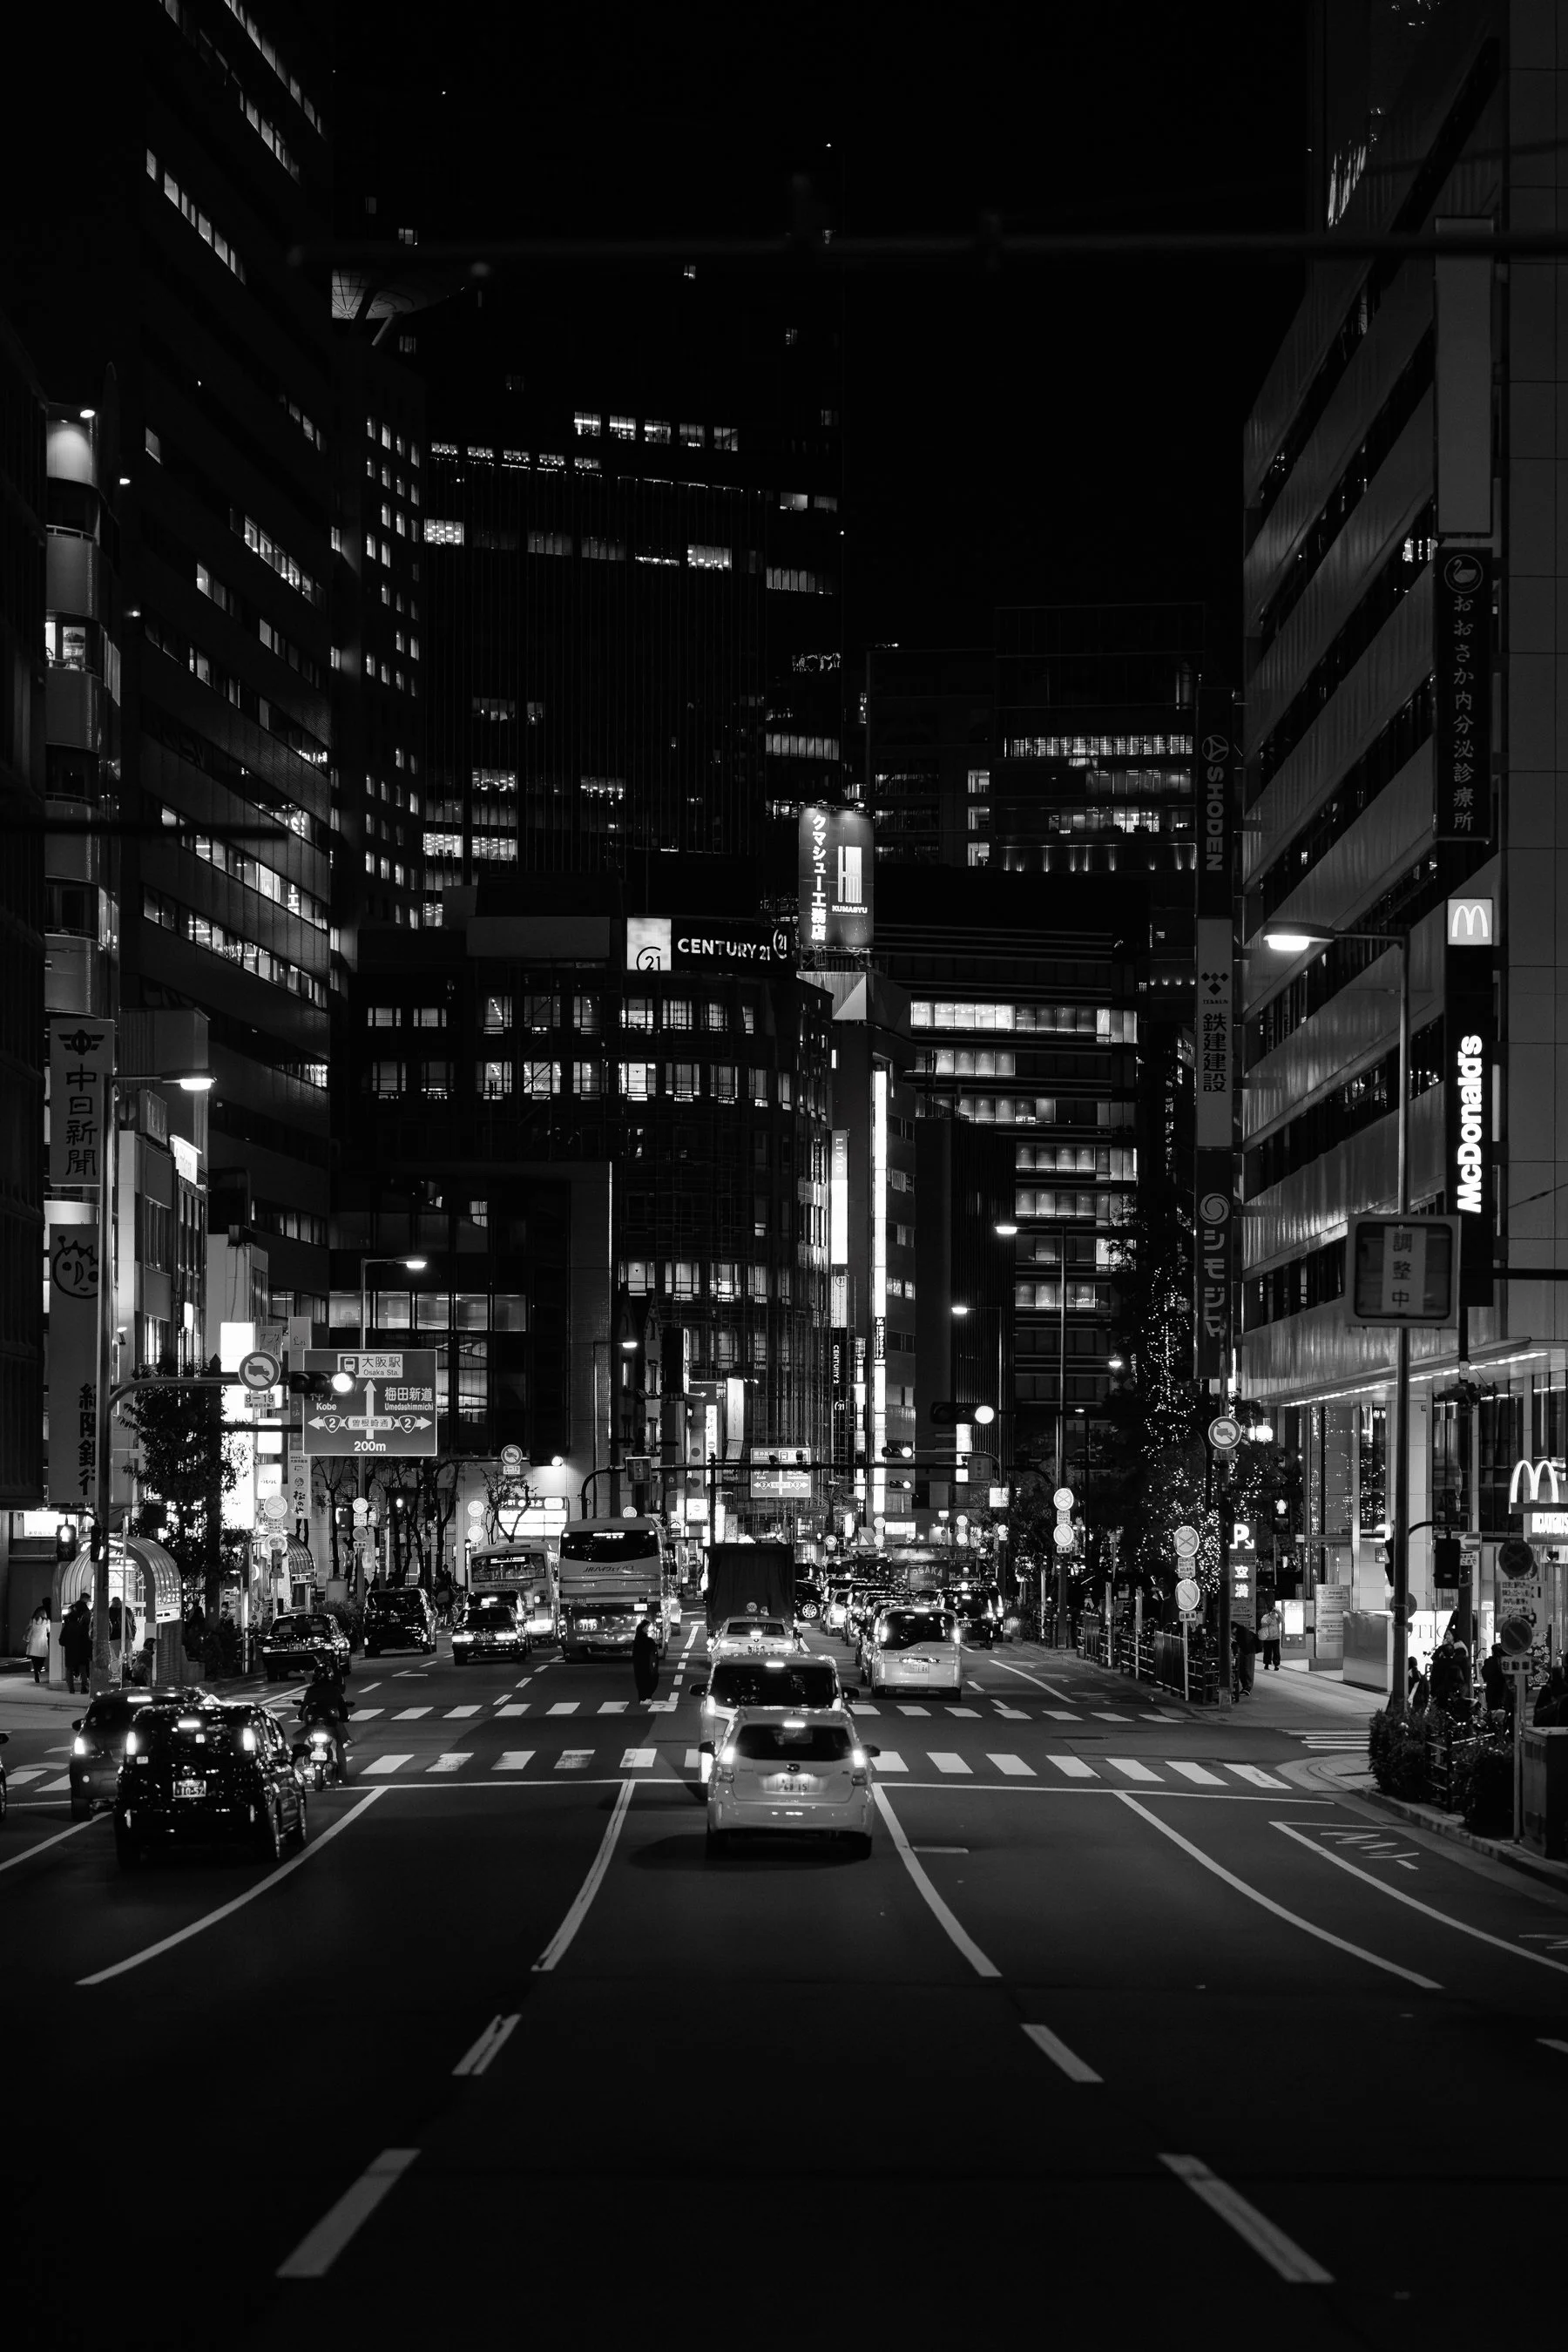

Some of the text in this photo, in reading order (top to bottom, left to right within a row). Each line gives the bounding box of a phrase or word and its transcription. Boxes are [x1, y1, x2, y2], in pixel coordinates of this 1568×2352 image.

[1453, 595, 1474, 832] おおさか内分泌診療所
[1206, 766, 1225, 870] SHODEN
[811, 814, 827, 941] クマシュー工務店
[677, 938, 771, 961] CENTURY 21
[1203, 1012, 1227, 1092] 鉄建建設
[65, 1063, 98, 1176] 中日新聞
[1457, 1035, 1483, 1213] McDonald's
[1392, 1232, 1413, 1308] 調整中
[362, 1355, 401, 1368] 大阪駅
[384, 1387, 433, 1402] 梅田新道
[384, 1402, 434, 1411] Umedashimmichi
[328, 1418, 336, 1429] 2
[404, 1418, 412, 1429] 2
[354, 1440, 387, 1452] 200m
[293, 1490, 306, 1514] 松のや
[1233, 1524, 1250, 1549] P
[1234, 1565, 1249, 1578] 空
[1234, 1584, 1249, 1598] 満
